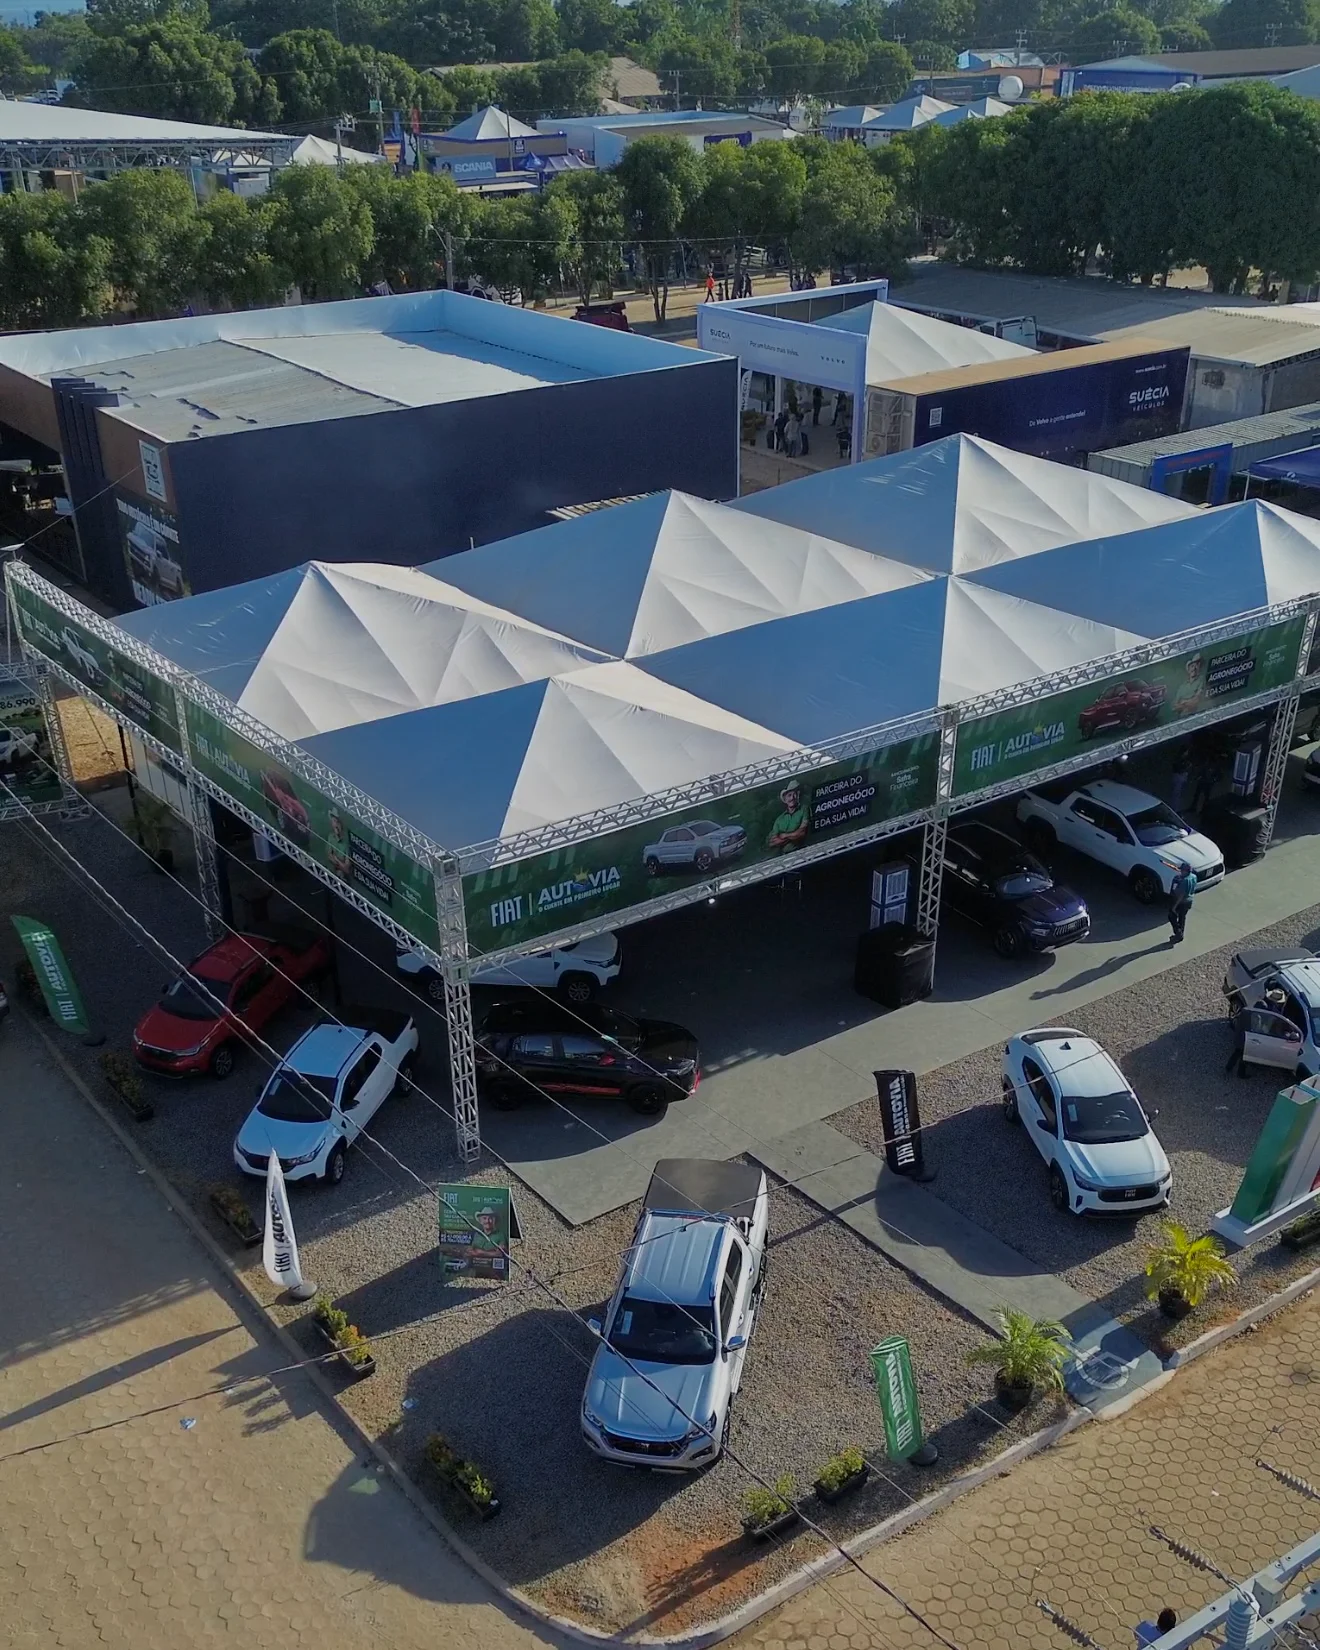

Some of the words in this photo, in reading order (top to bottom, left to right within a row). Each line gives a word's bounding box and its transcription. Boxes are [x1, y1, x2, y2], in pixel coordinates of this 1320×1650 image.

[454, 162, 493, 173] SCANIA
[820, 355, 846, 364] VOLVO
[1237, 649, 1247, 657] DO
[1208, 661, 1254, 682] AGRONEGÓCIO
[1209, 687, 1218, 696] DA
[1218, 683, 1230, 693] SUA
[971, 744, 996, 771] FIAT
[816, 780, 850, 797] PARCEIRA
[850, 775, 863, 786] DO
[815, 787, 875, 813] AGRONEGÓCIO
[814, 821, 820, 829] E
[820, 817, 831, 827] DA
[831, 812, 847, 823] SUA
[847, 805, 867, 817] VIDA!
[544, 901, 563, 911] CLIENTE
[564, 897, 573, 905] EM
[574, 888, 602, 901] PRIMEIRO
[602, 881, 620, 892] LUGAR
[490, 896, 522, 927] FIAT
[57, 1000, 78, 1021] FIAT
[889, 1076, 906, 1136] AUTOVIA
[896, 1142, 915, 1166] FIAT
[443, 1192, 459, 1203] FIAT
[274, 1252, 291, 1273] FIAT
[885, 1352, 904, 1418] AUTOVIA
[896, 1420, 913, 1452] FIAT
